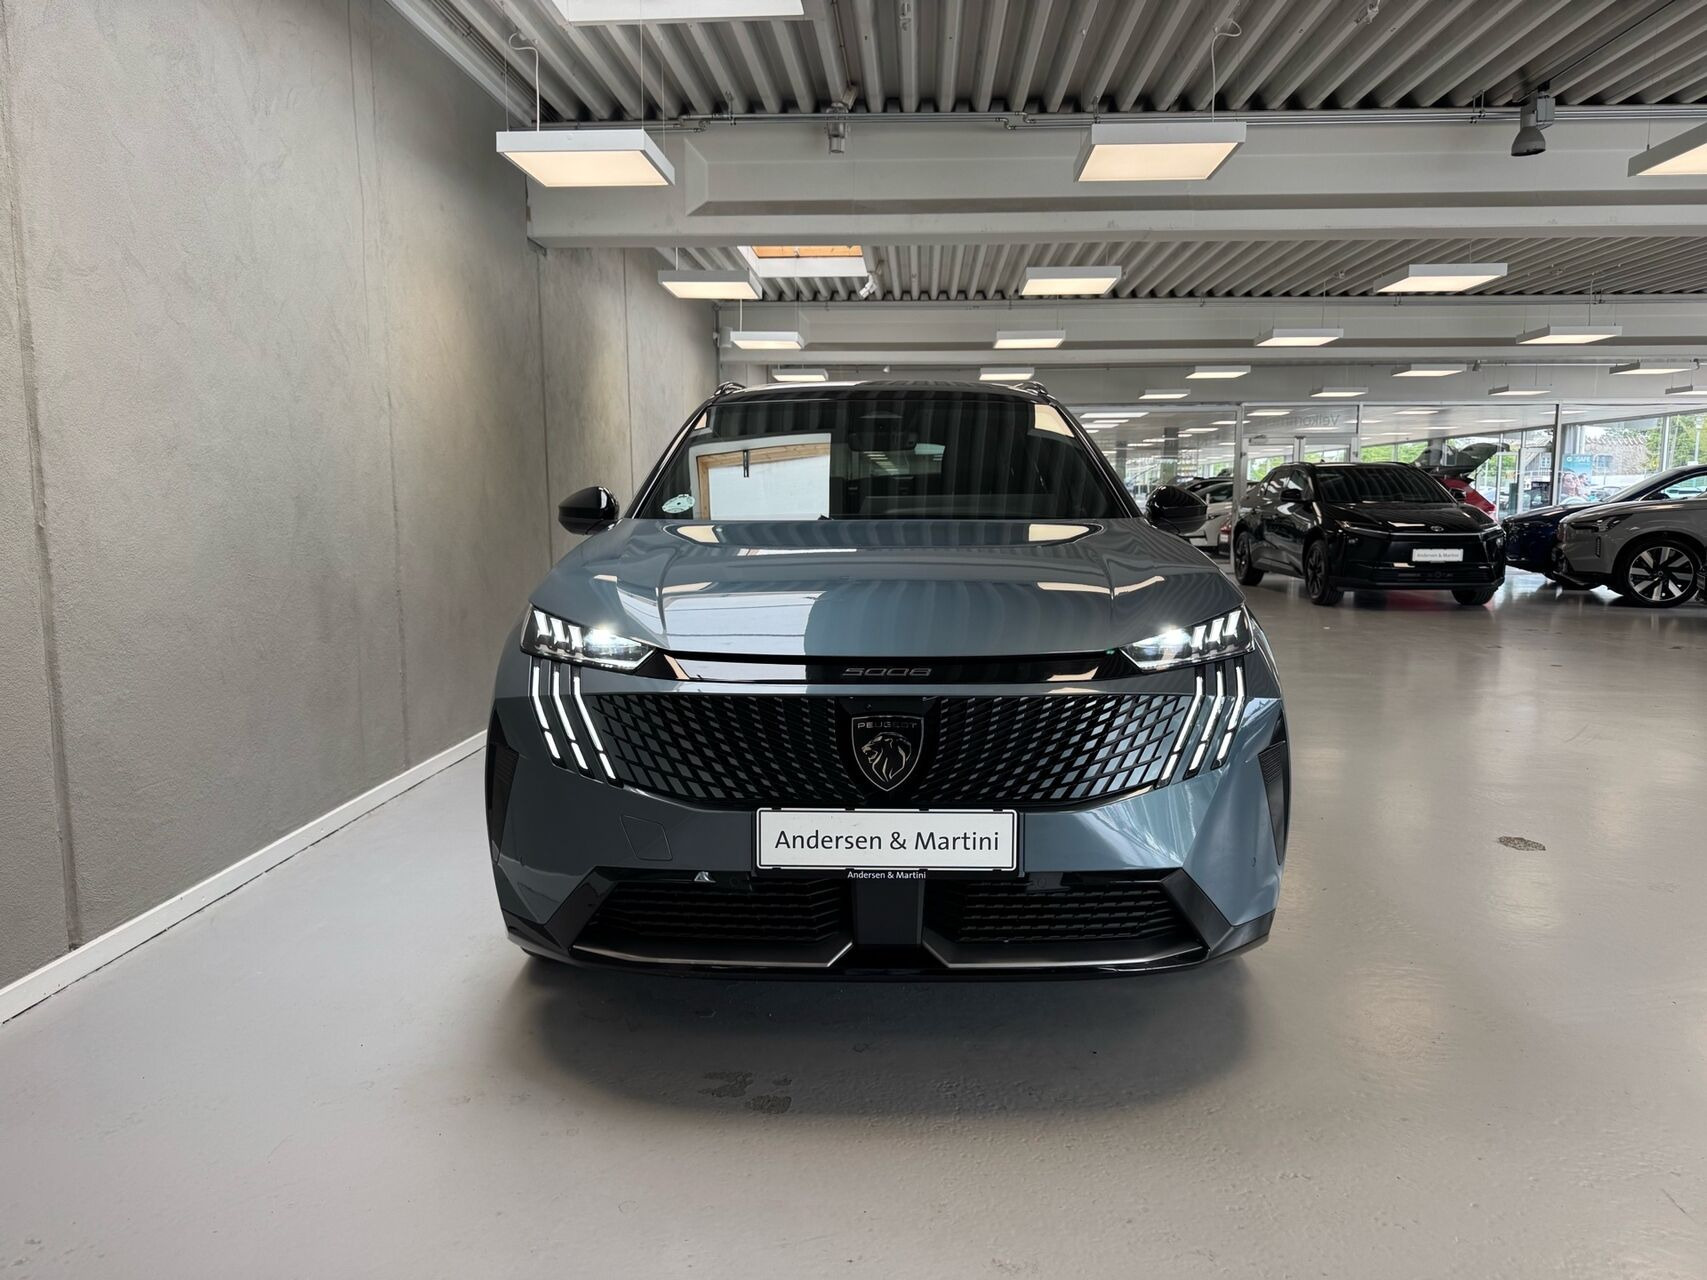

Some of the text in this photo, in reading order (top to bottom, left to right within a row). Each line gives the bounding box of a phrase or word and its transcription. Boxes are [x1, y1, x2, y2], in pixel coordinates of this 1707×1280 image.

[842, 667, 932, 677] 5008
[857, 721, 918, 729] PEUGEOT
[775, 830, 999, 851] Andersen & Martini
[847, 871, 926, 880] Andersen & Martini
